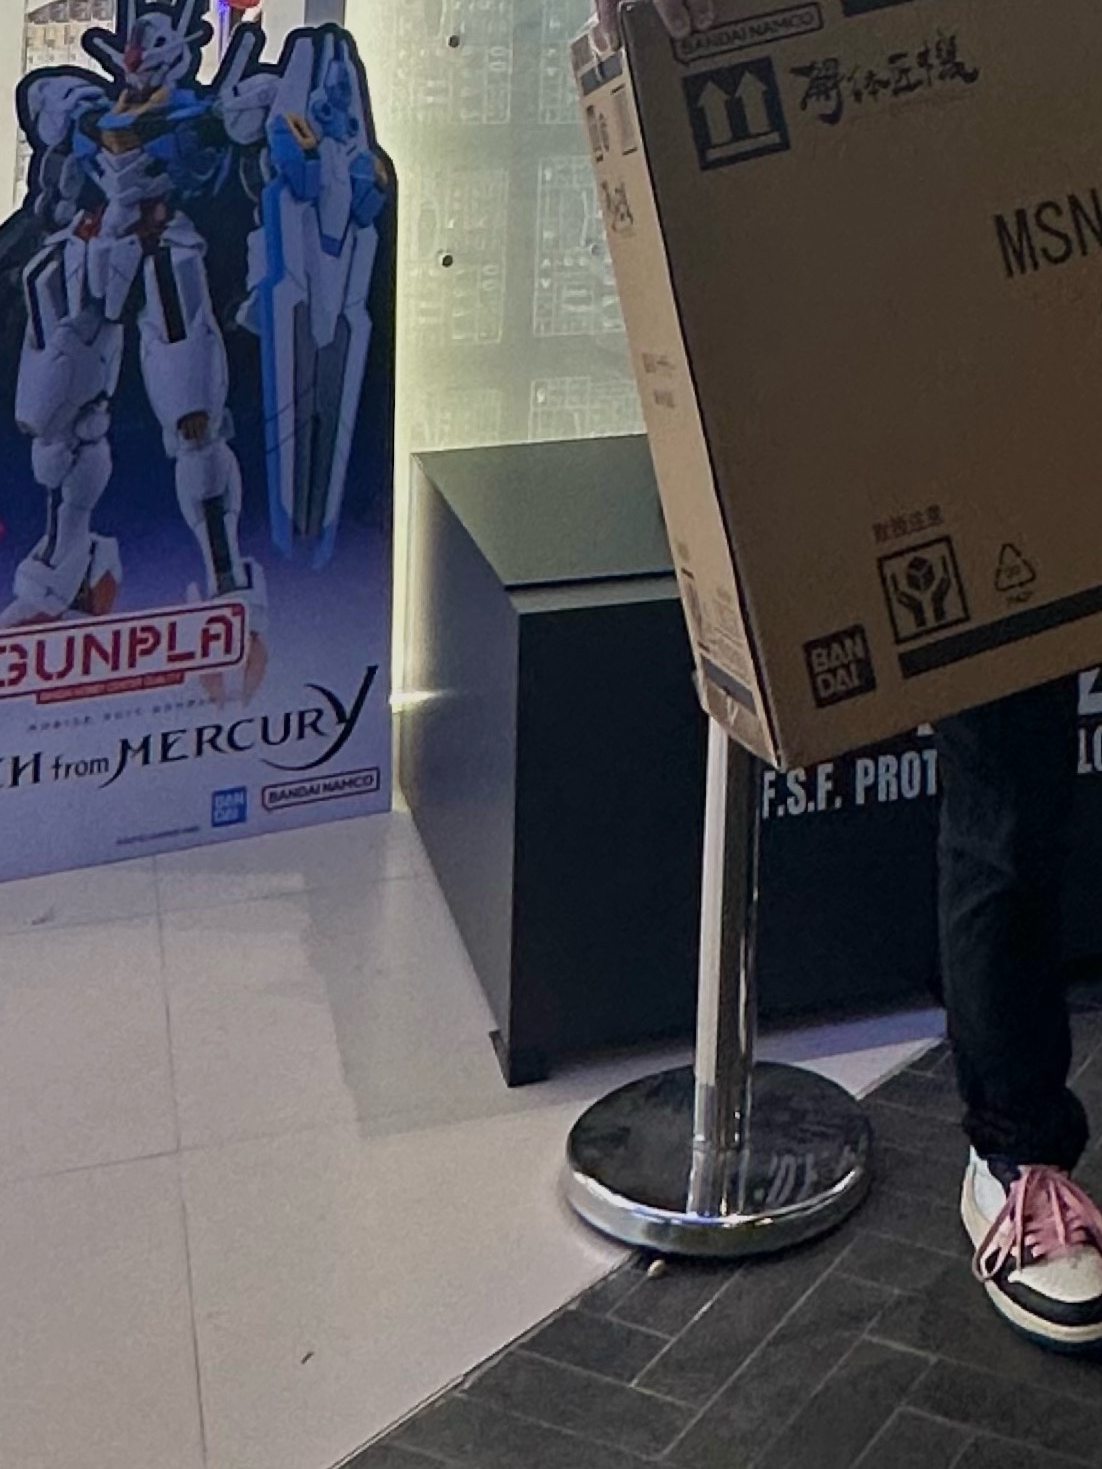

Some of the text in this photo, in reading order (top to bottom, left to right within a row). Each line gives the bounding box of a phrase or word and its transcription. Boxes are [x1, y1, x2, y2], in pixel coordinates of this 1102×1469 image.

[747, 11, 815, 38] NAMCO
[0, 616, 233, 688] GUNPLA
[811, 635, 865, 674] BAN
[816, 662, 861, 699] DAI
[0, 751, 41, 789] H
[52, 754, 110, 778] from
[98, 665, 379, 789] MERCURY
[269, 773, 374, 803] BANDAI NAMCO
[855, 749, 938, 805] PROT
